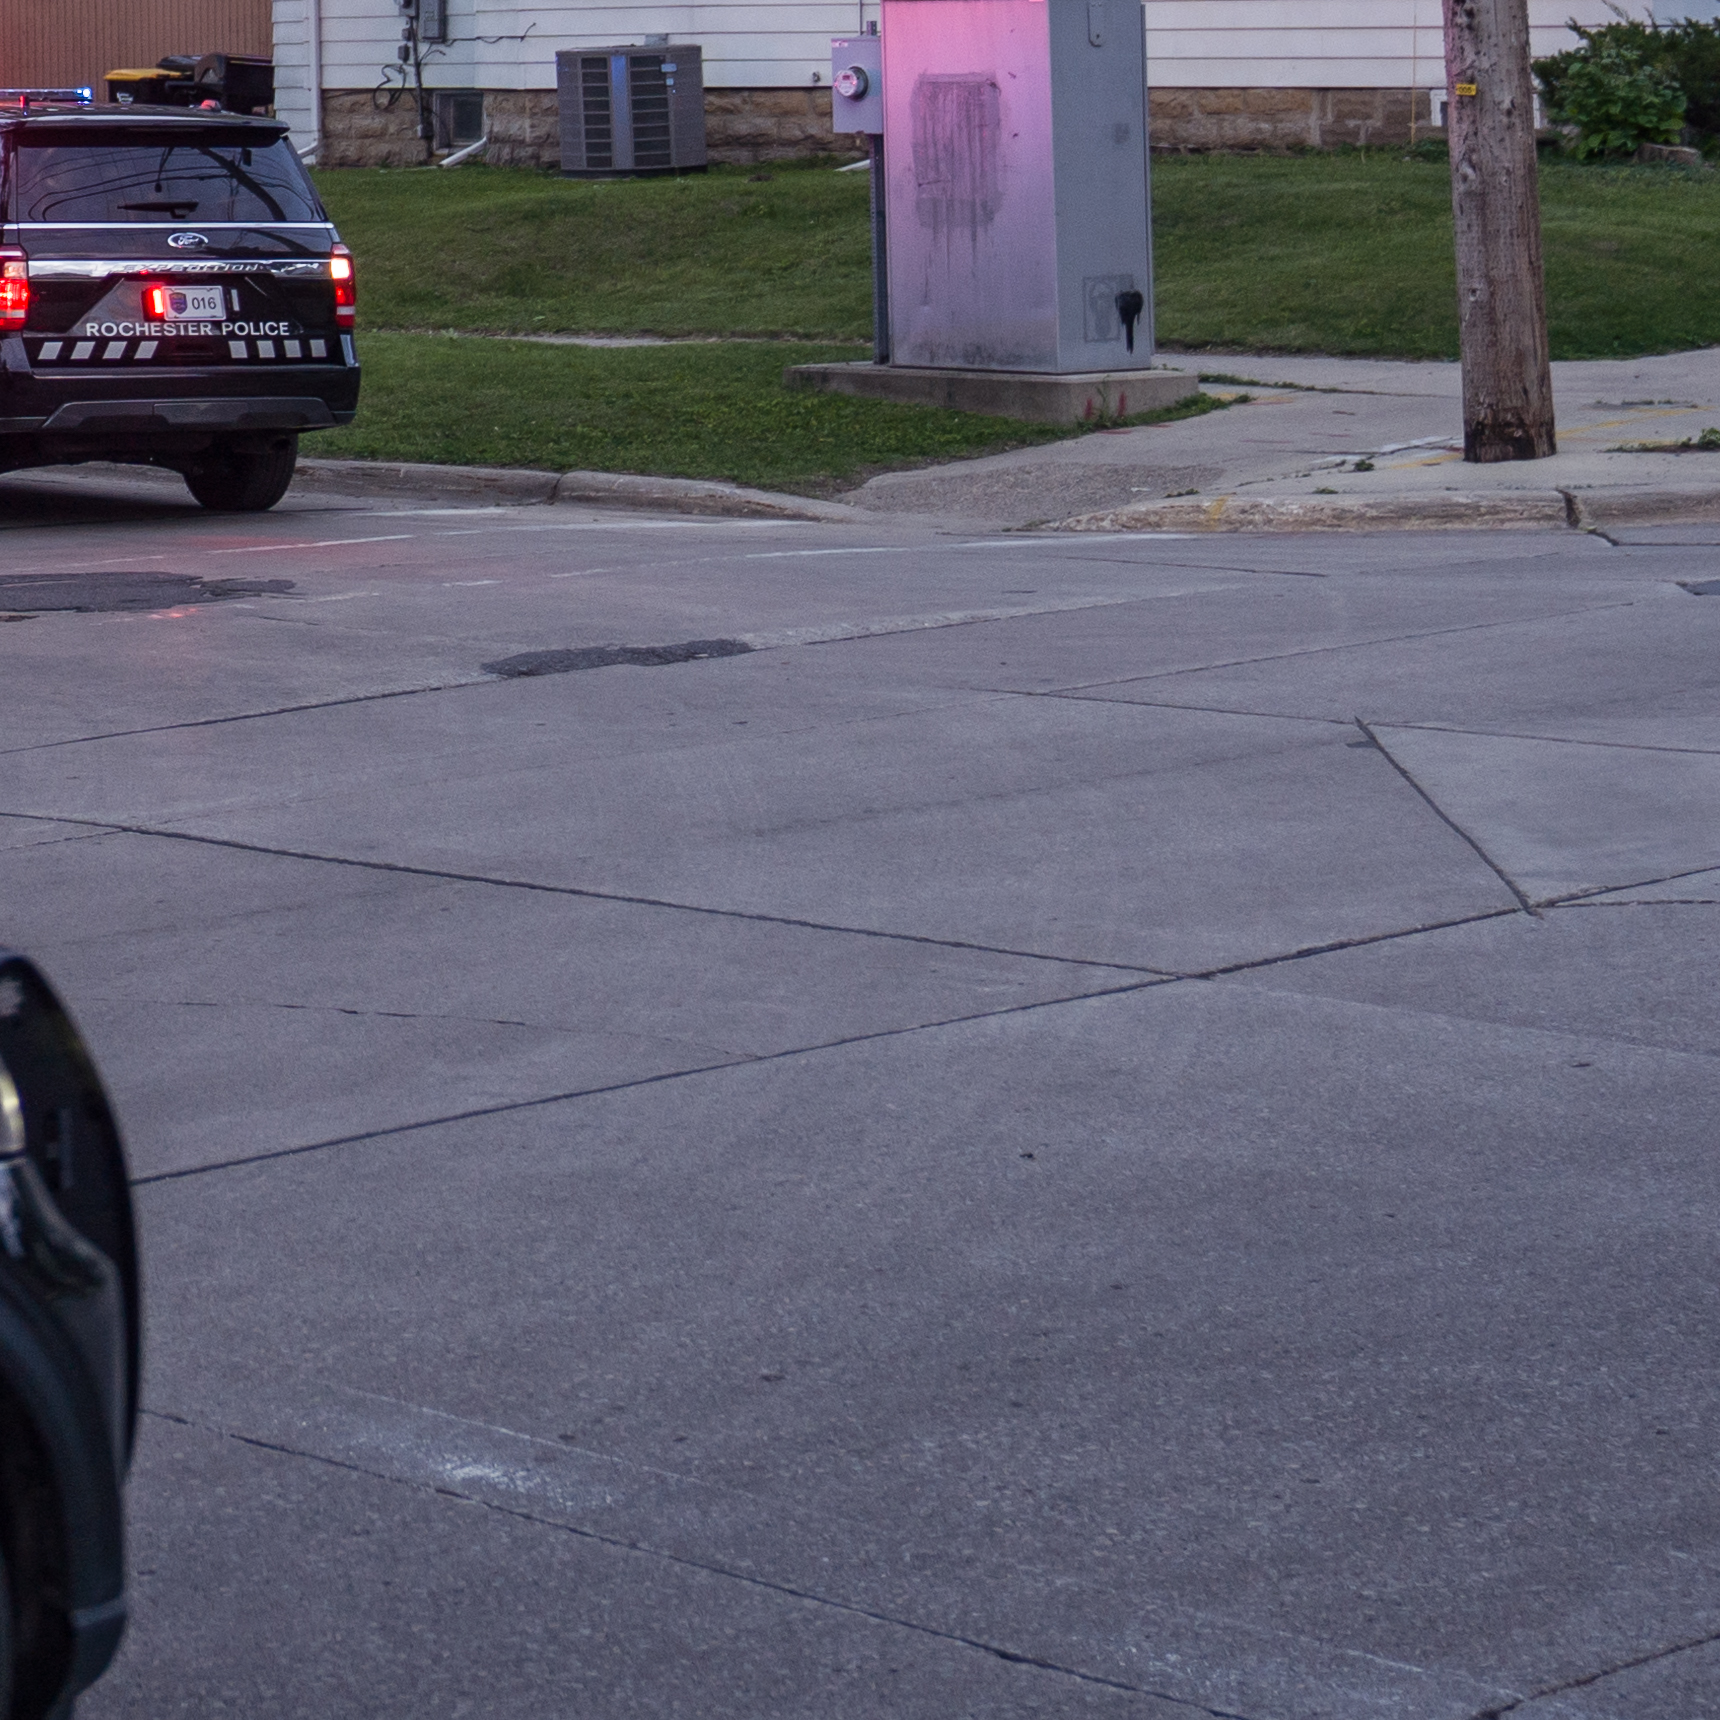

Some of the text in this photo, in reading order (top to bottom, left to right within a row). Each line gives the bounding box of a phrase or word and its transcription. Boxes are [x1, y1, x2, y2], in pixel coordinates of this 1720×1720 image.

[123, 263, 258, 273] EXPEDITION
[191, 296, 217, 310] 016
[86, 322, 290, 336] ROCHESTER POLICE
